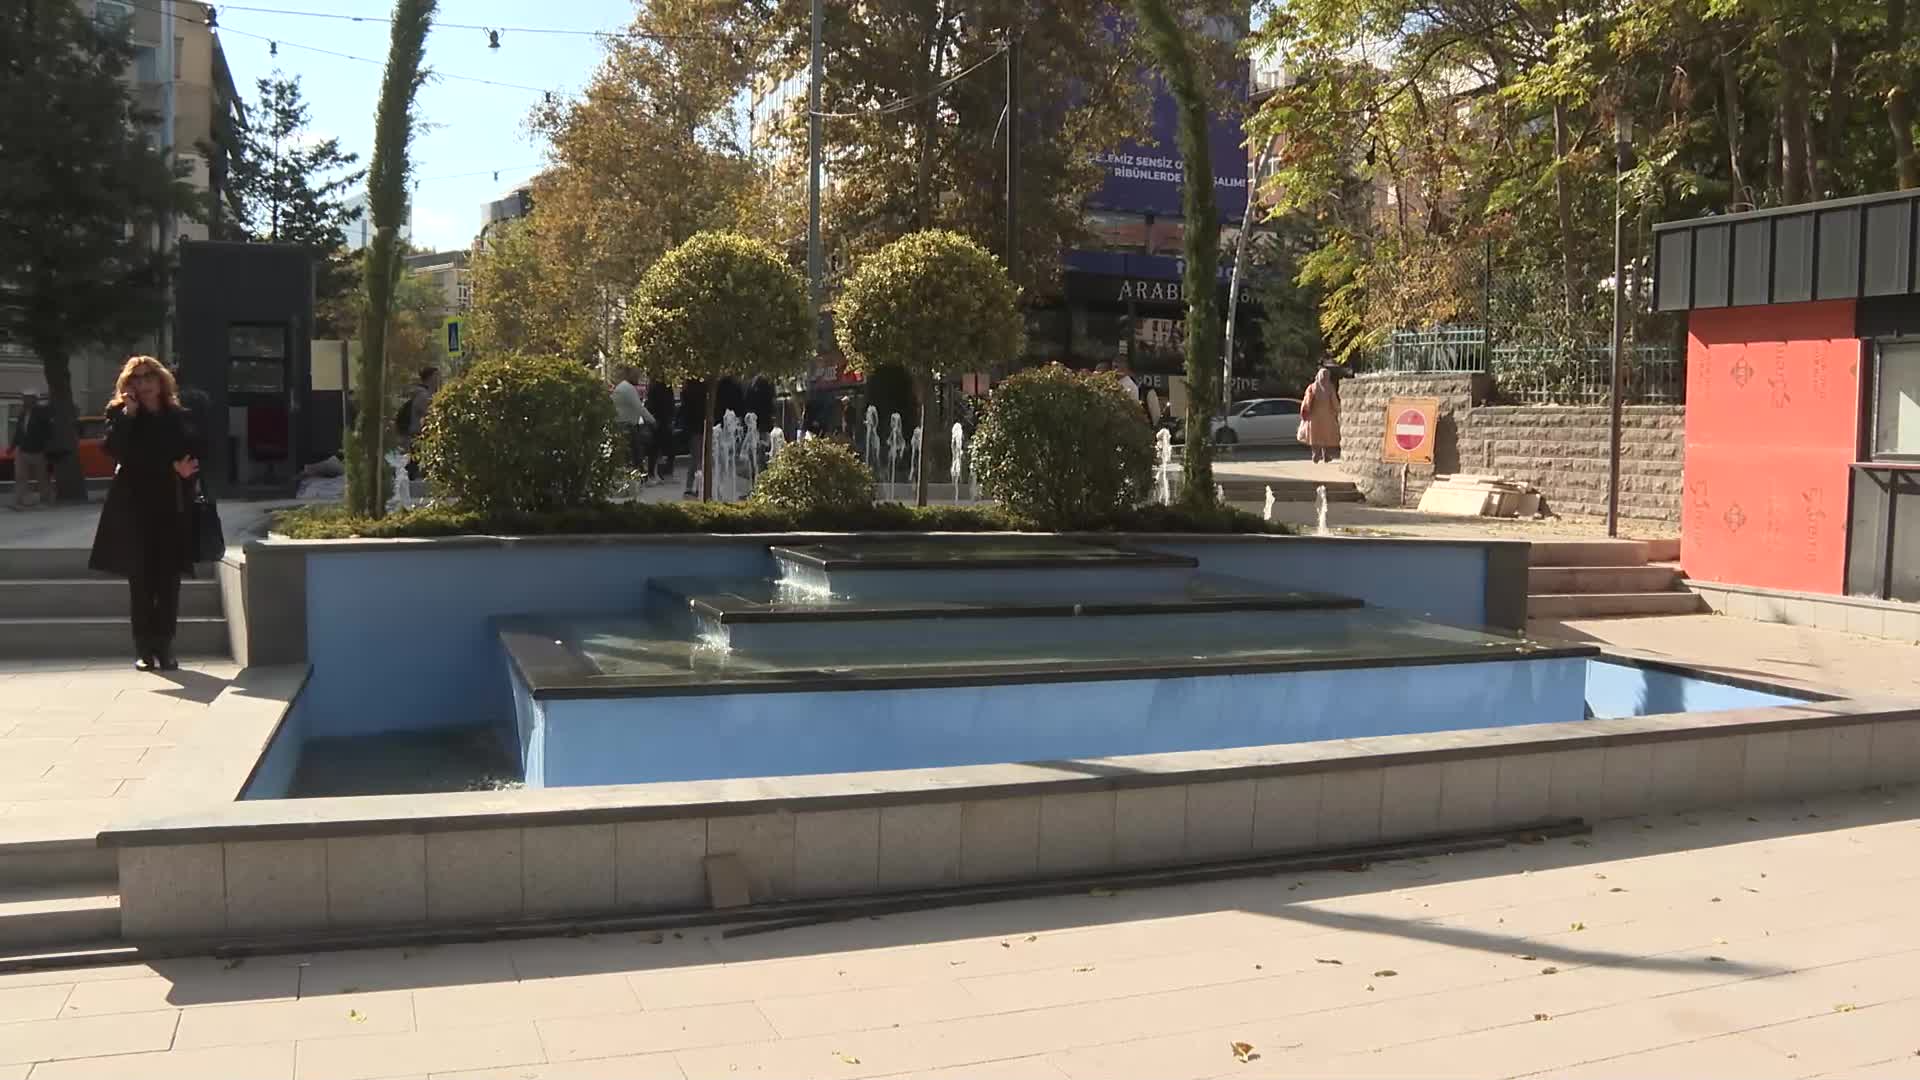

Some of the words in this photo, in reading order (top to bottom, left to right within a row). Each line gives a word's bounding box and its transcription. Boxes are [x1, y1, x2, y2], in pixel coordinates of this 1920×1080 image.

[1136, 156, 1173, 169] SENSİZ
[1113, 165, 1182, 182] RİBÜNLERDE
[1117, 280, 1185, 301] ARABI
